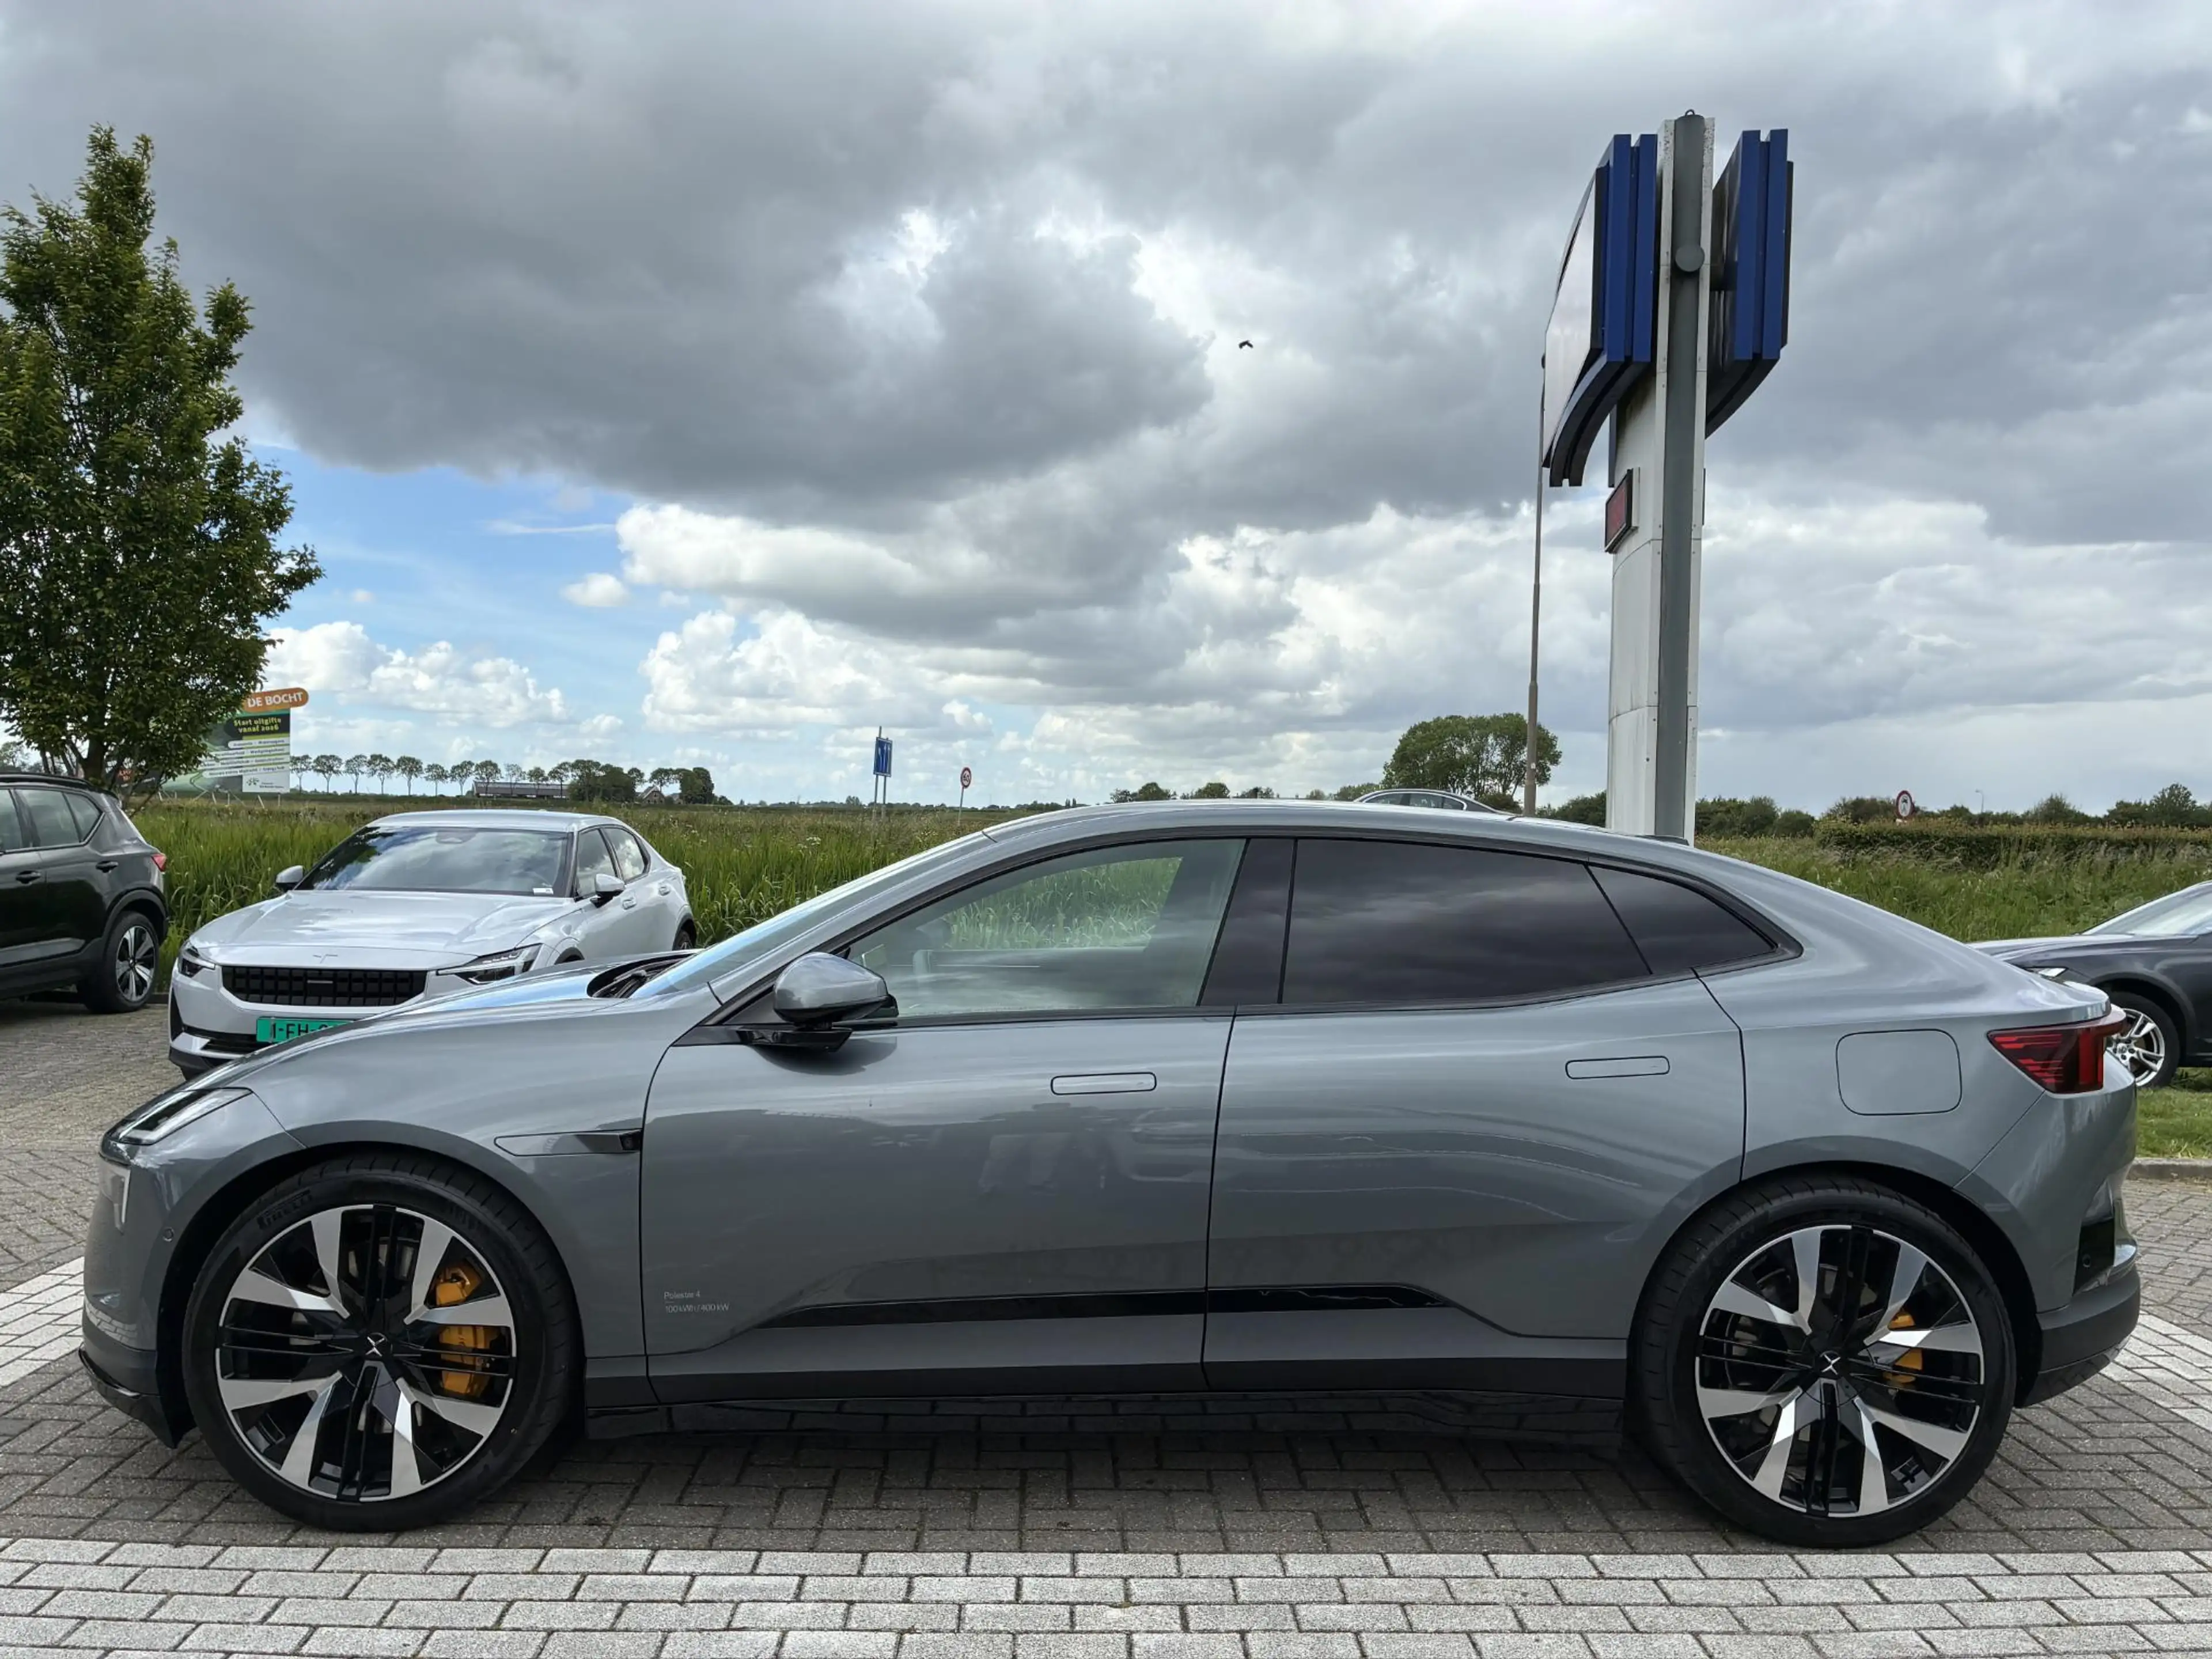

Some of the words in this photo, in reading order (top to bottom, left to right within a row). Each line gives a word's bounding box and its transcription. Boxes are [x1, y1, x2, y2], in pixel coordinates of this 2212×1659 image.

[247, 697, 263, 708] DE
[265, 692, 303, 706] BOCHT
[664, 1291, 694, 1300] Polestar
[665, 1305, 678, 1313] 100
